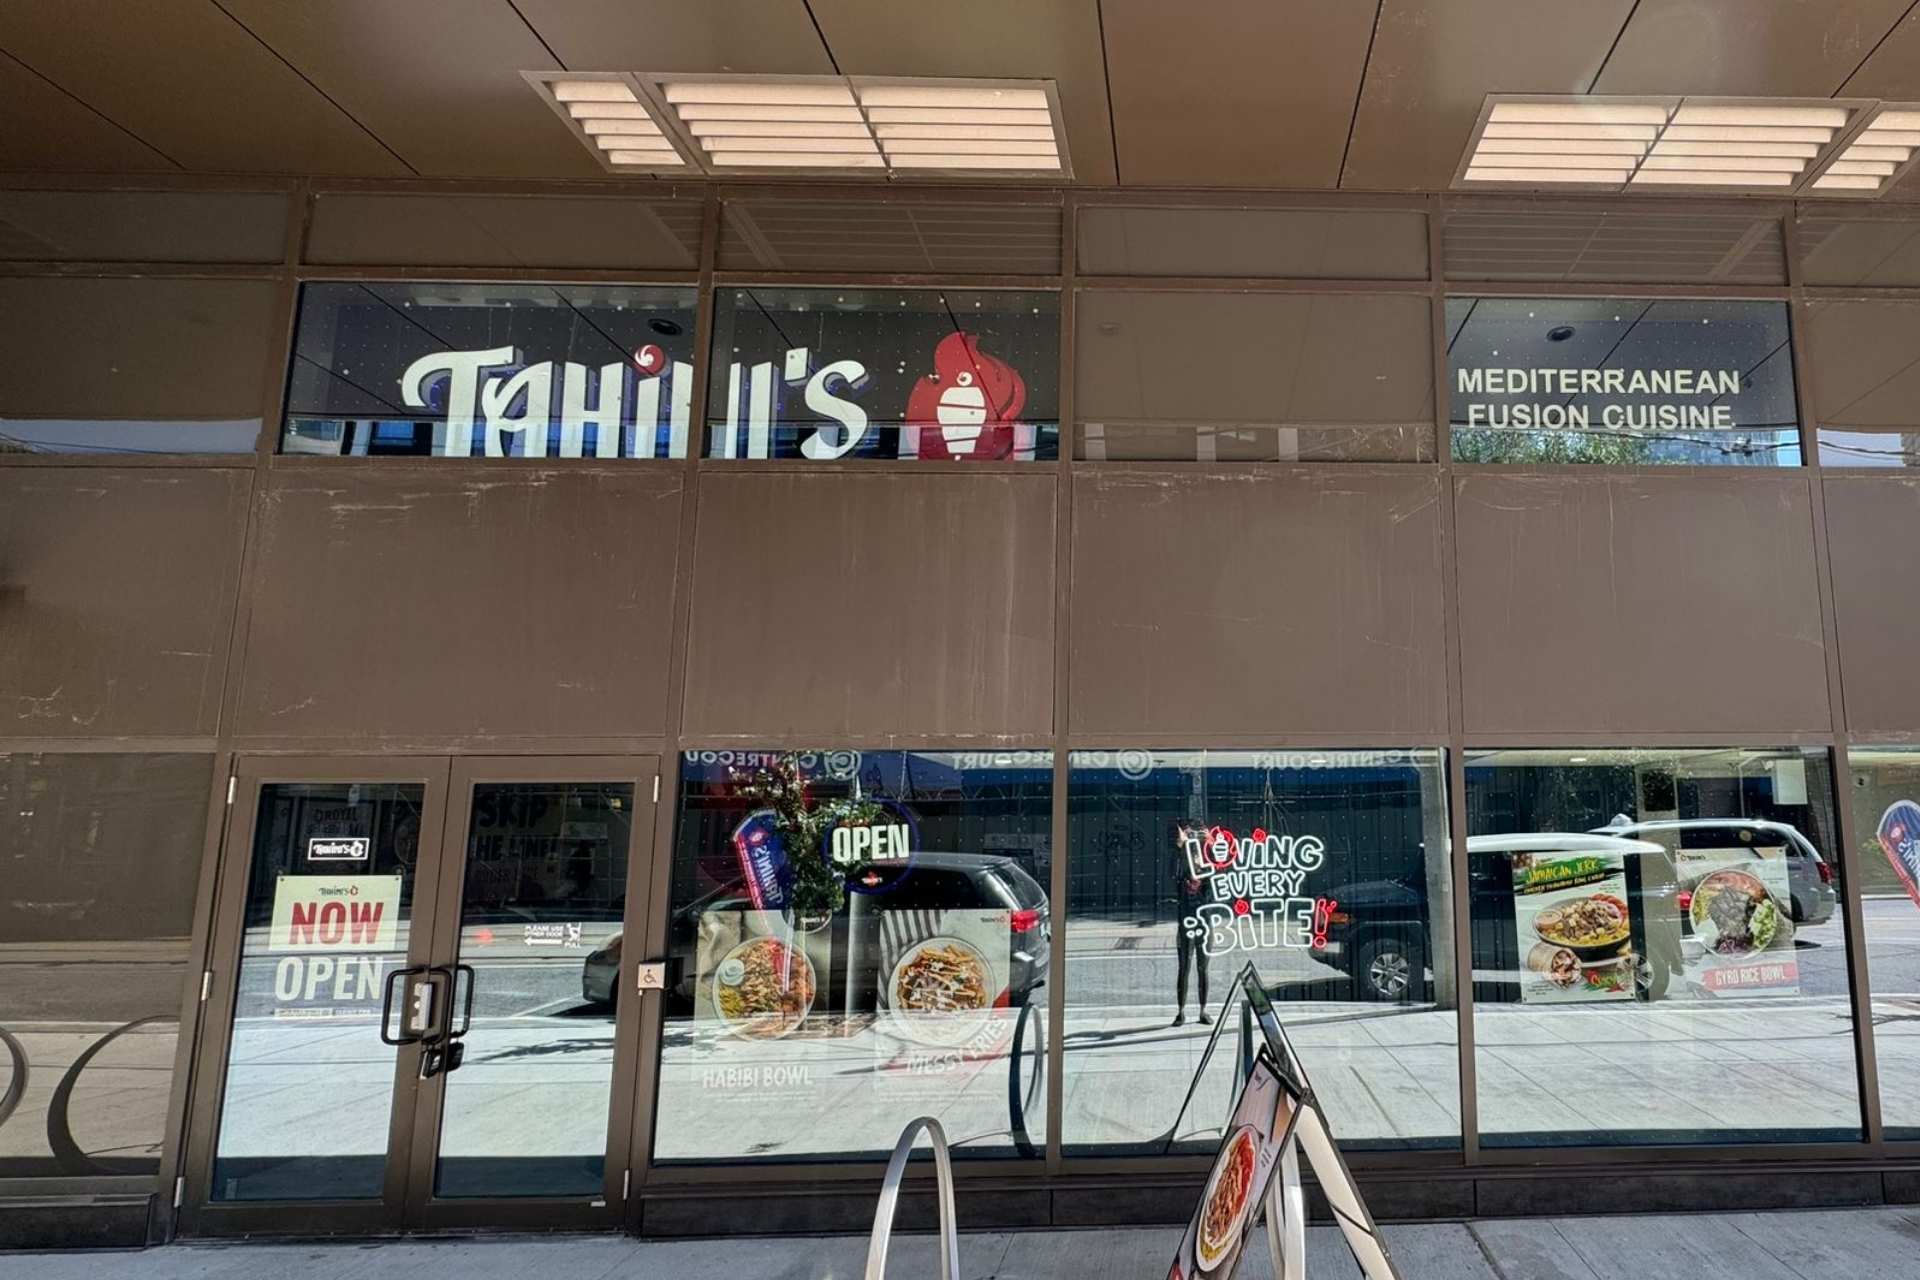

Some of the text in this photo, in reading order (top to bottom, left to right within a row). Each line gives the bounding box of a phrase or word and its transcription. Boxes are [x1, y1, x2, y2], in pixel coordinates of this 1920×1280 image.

[1457, 368, 1740, 394] MEDITERRANEAN
[1467, 404, 1733, 430] FUSION CUISINE
[832, 823, 910, 863] OPEN
[1210, 870, 1305, 901] EVERY
[288, 902, 384, 945] NOW
[274, 956, 384, 1001] OPEN
[1715, 968, 1739, 986] GYRO
[1740, 966, 1760, 984] RICE
[703, 1065, 813, 1089] HABIBI BOWL
